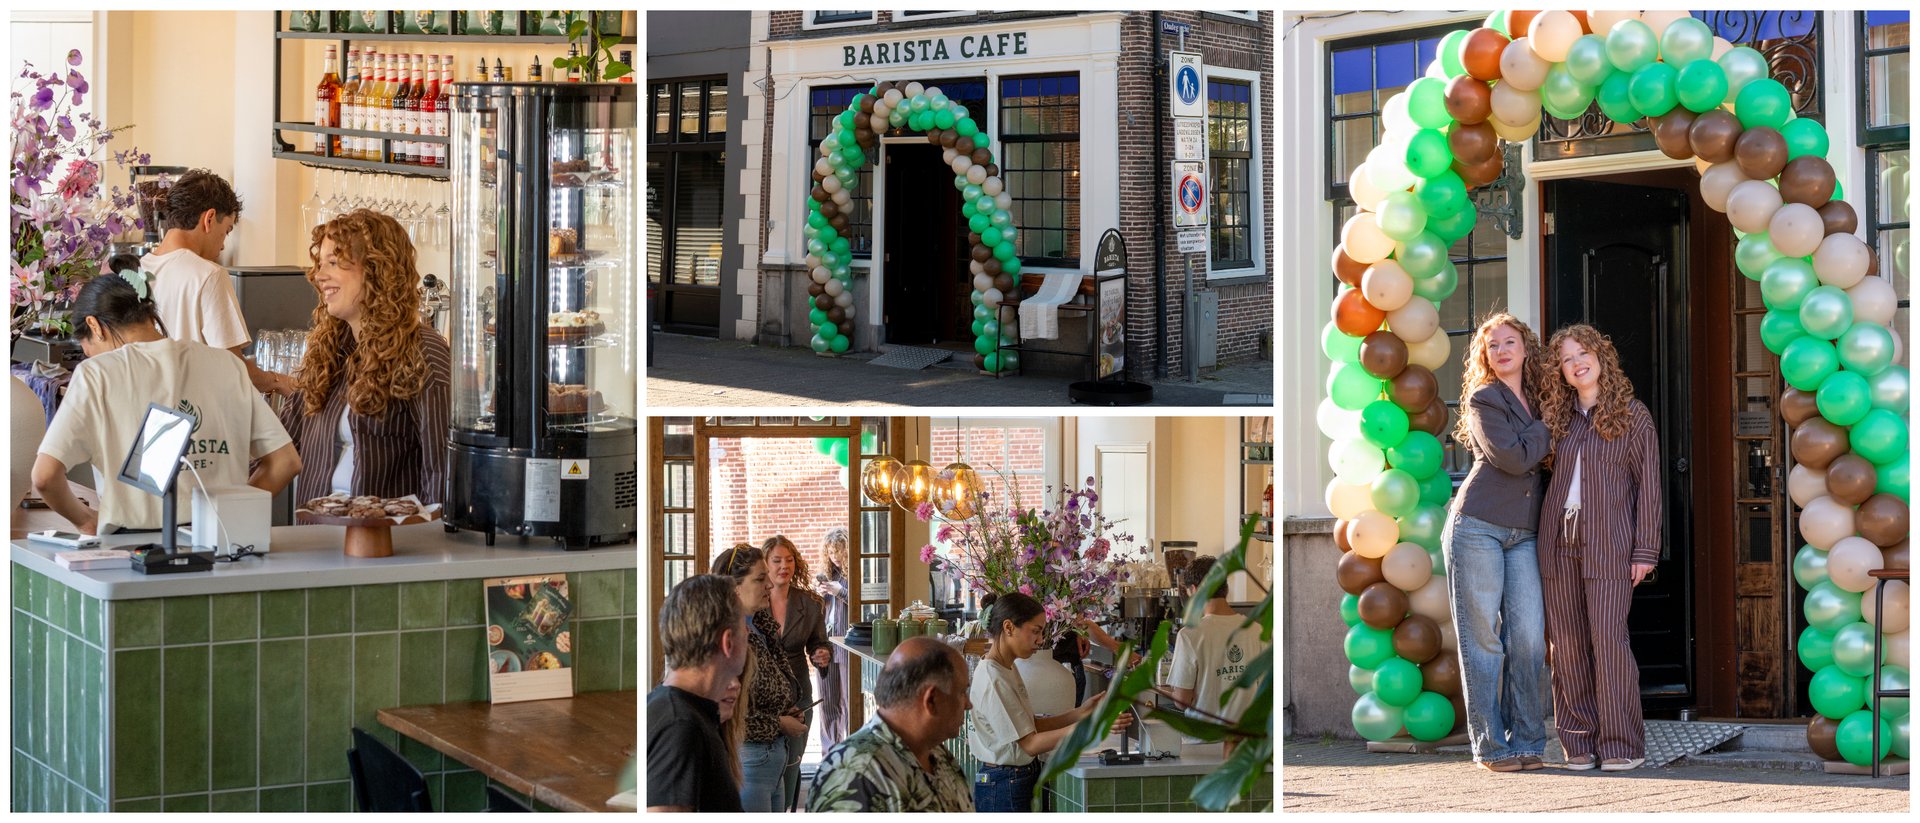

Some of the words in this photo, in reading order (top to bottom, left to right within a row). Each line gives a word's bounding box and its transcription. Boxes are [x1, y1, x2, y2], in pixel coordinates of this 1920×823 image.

[843, 38, 950, 66] BARISTA
[960, 32, 1027, 58] CAFE
[1180, 56, 1194, 64] ZONE
[1183, 164, 1197, 172] ZONE
[1216, 665, 1247, 677] BARIS
